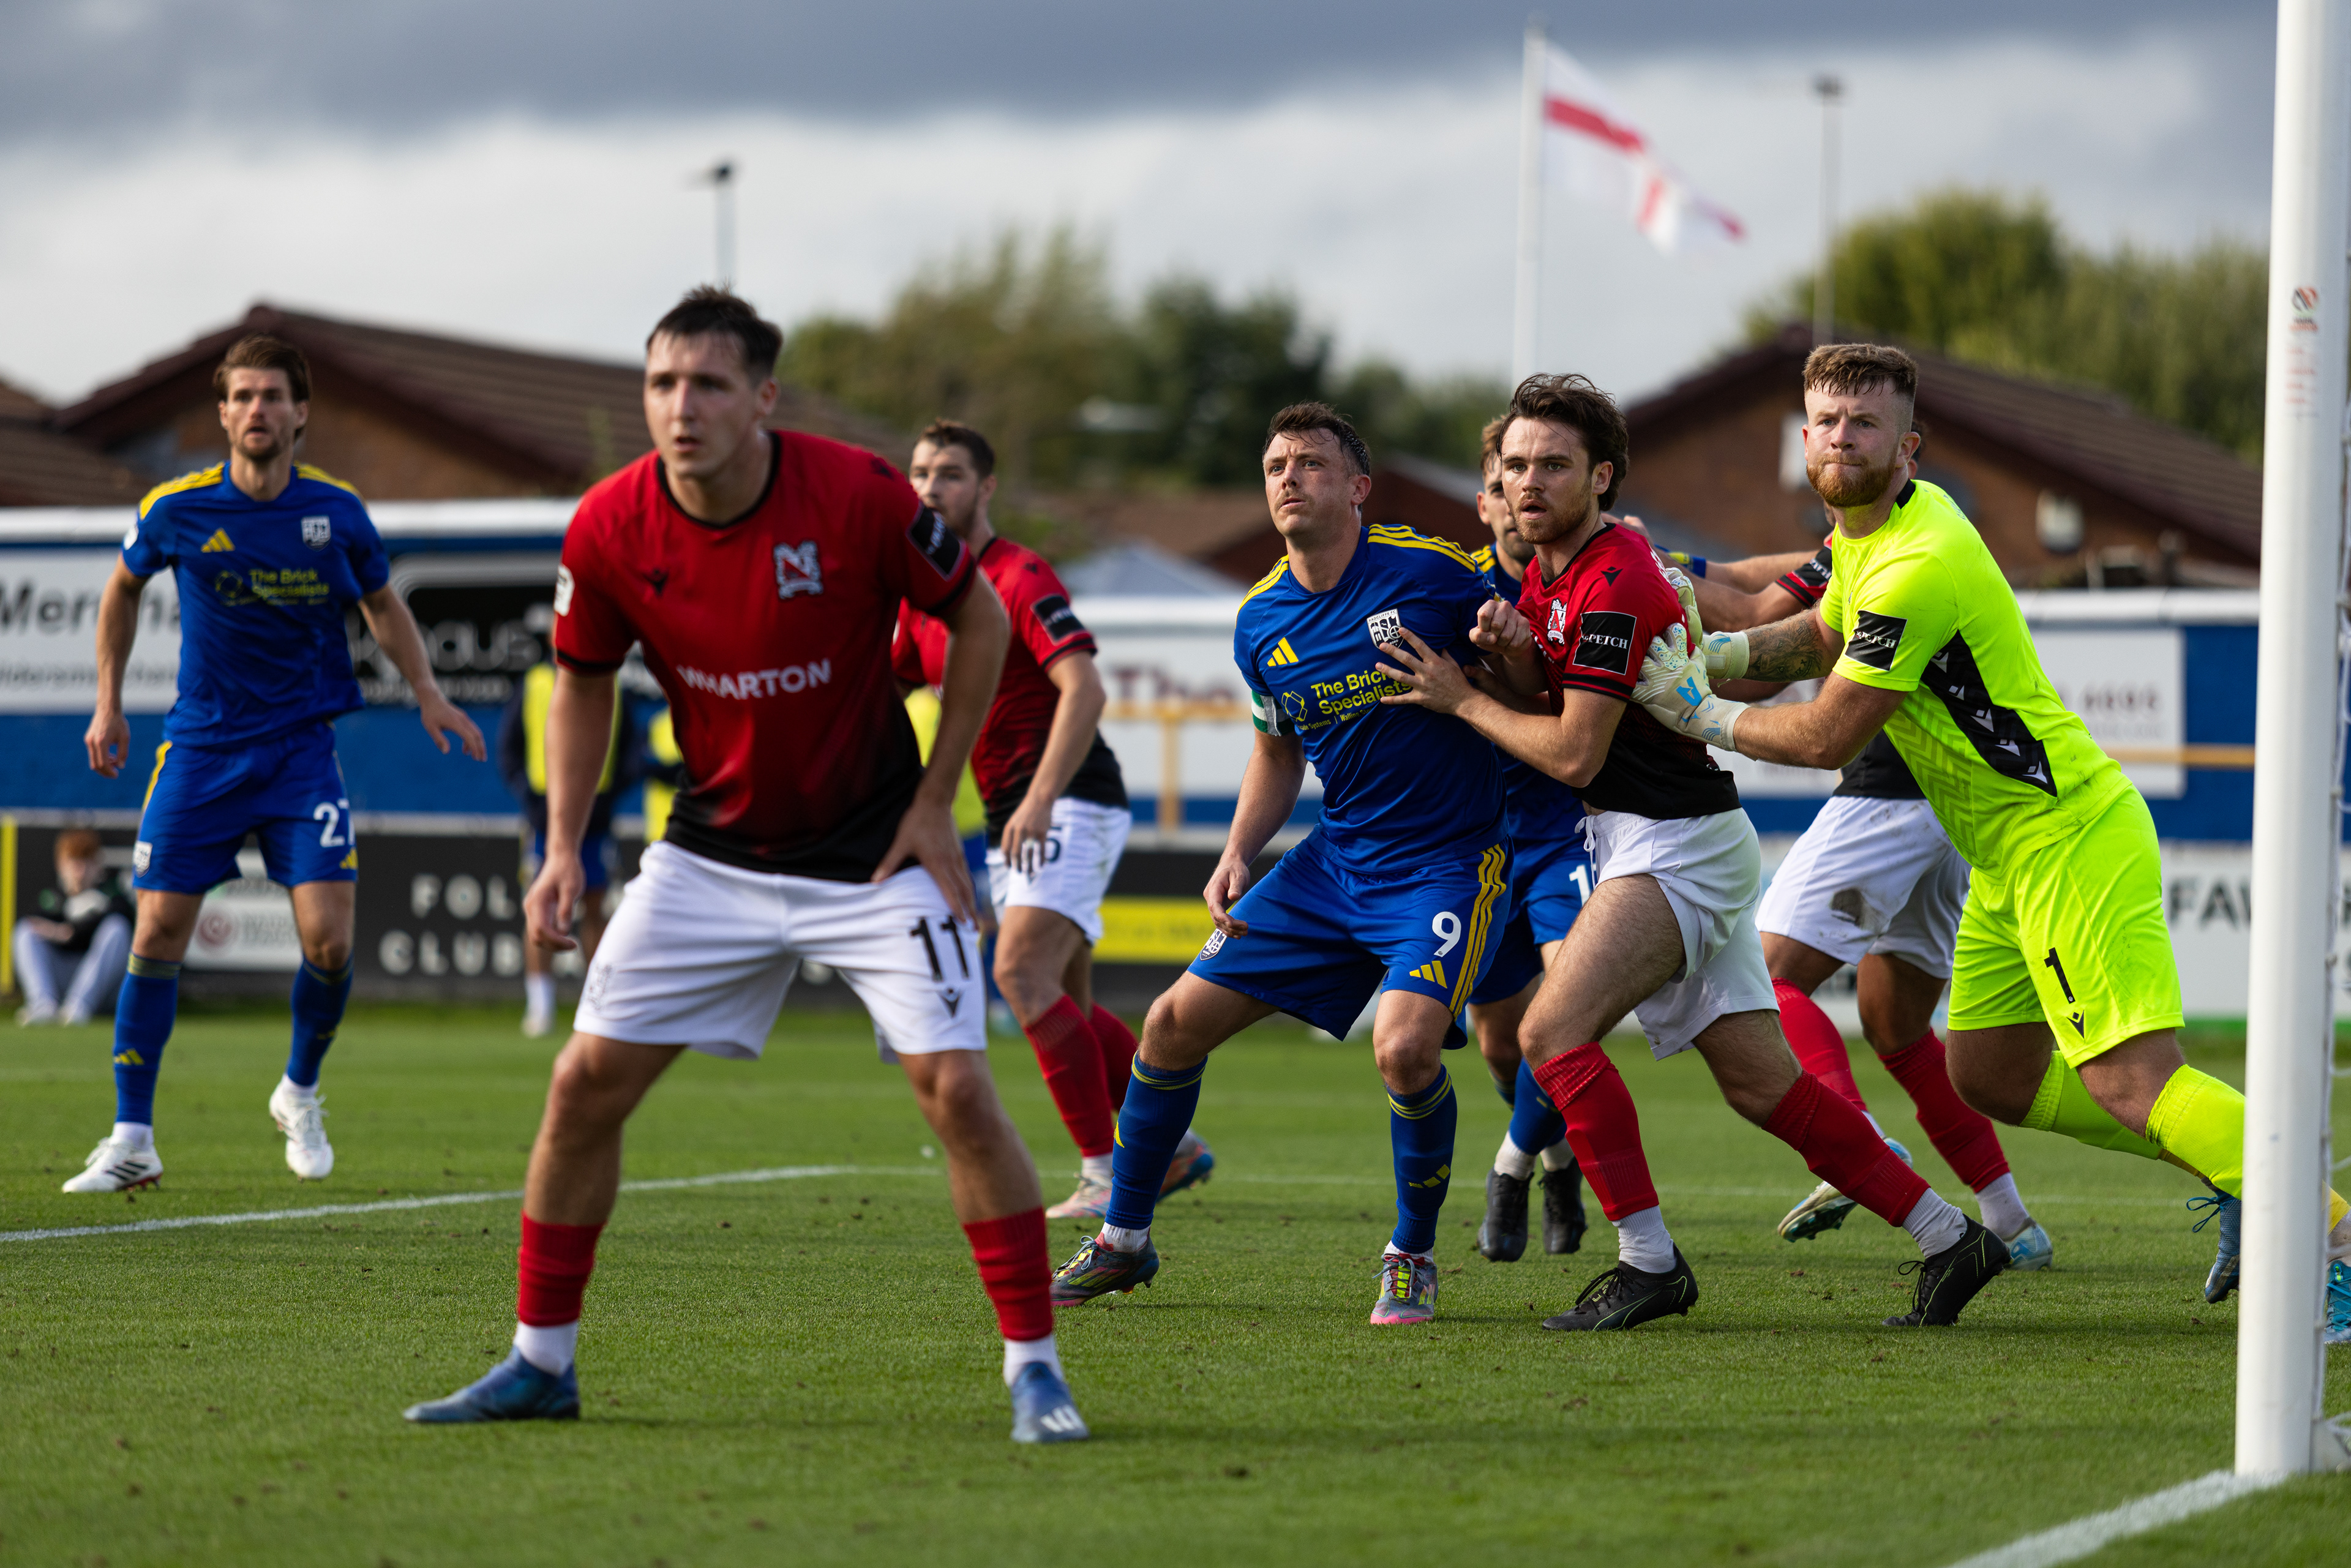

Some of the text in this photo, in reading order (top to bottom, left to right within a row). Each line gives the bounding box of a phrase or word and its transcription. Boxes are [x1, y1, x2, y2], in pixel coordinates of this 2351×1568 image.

[249, 567, 318, 583] The Brick
[1368, 612, 1390, 622] RADCLIFFE
[1589, 634, 1629, 650] PETCH
[676, 658, 832, 700] WHARTON
[1311, 681, 1344, 699] The
[1319, 680, 1412, 715] Specialists
[1308, 719, 1332, 730] Systems
[1431, 911, 1461, 958] 9
[909, 915, 970, 983] 11
[2044, 947, 2076, 1004] 1
